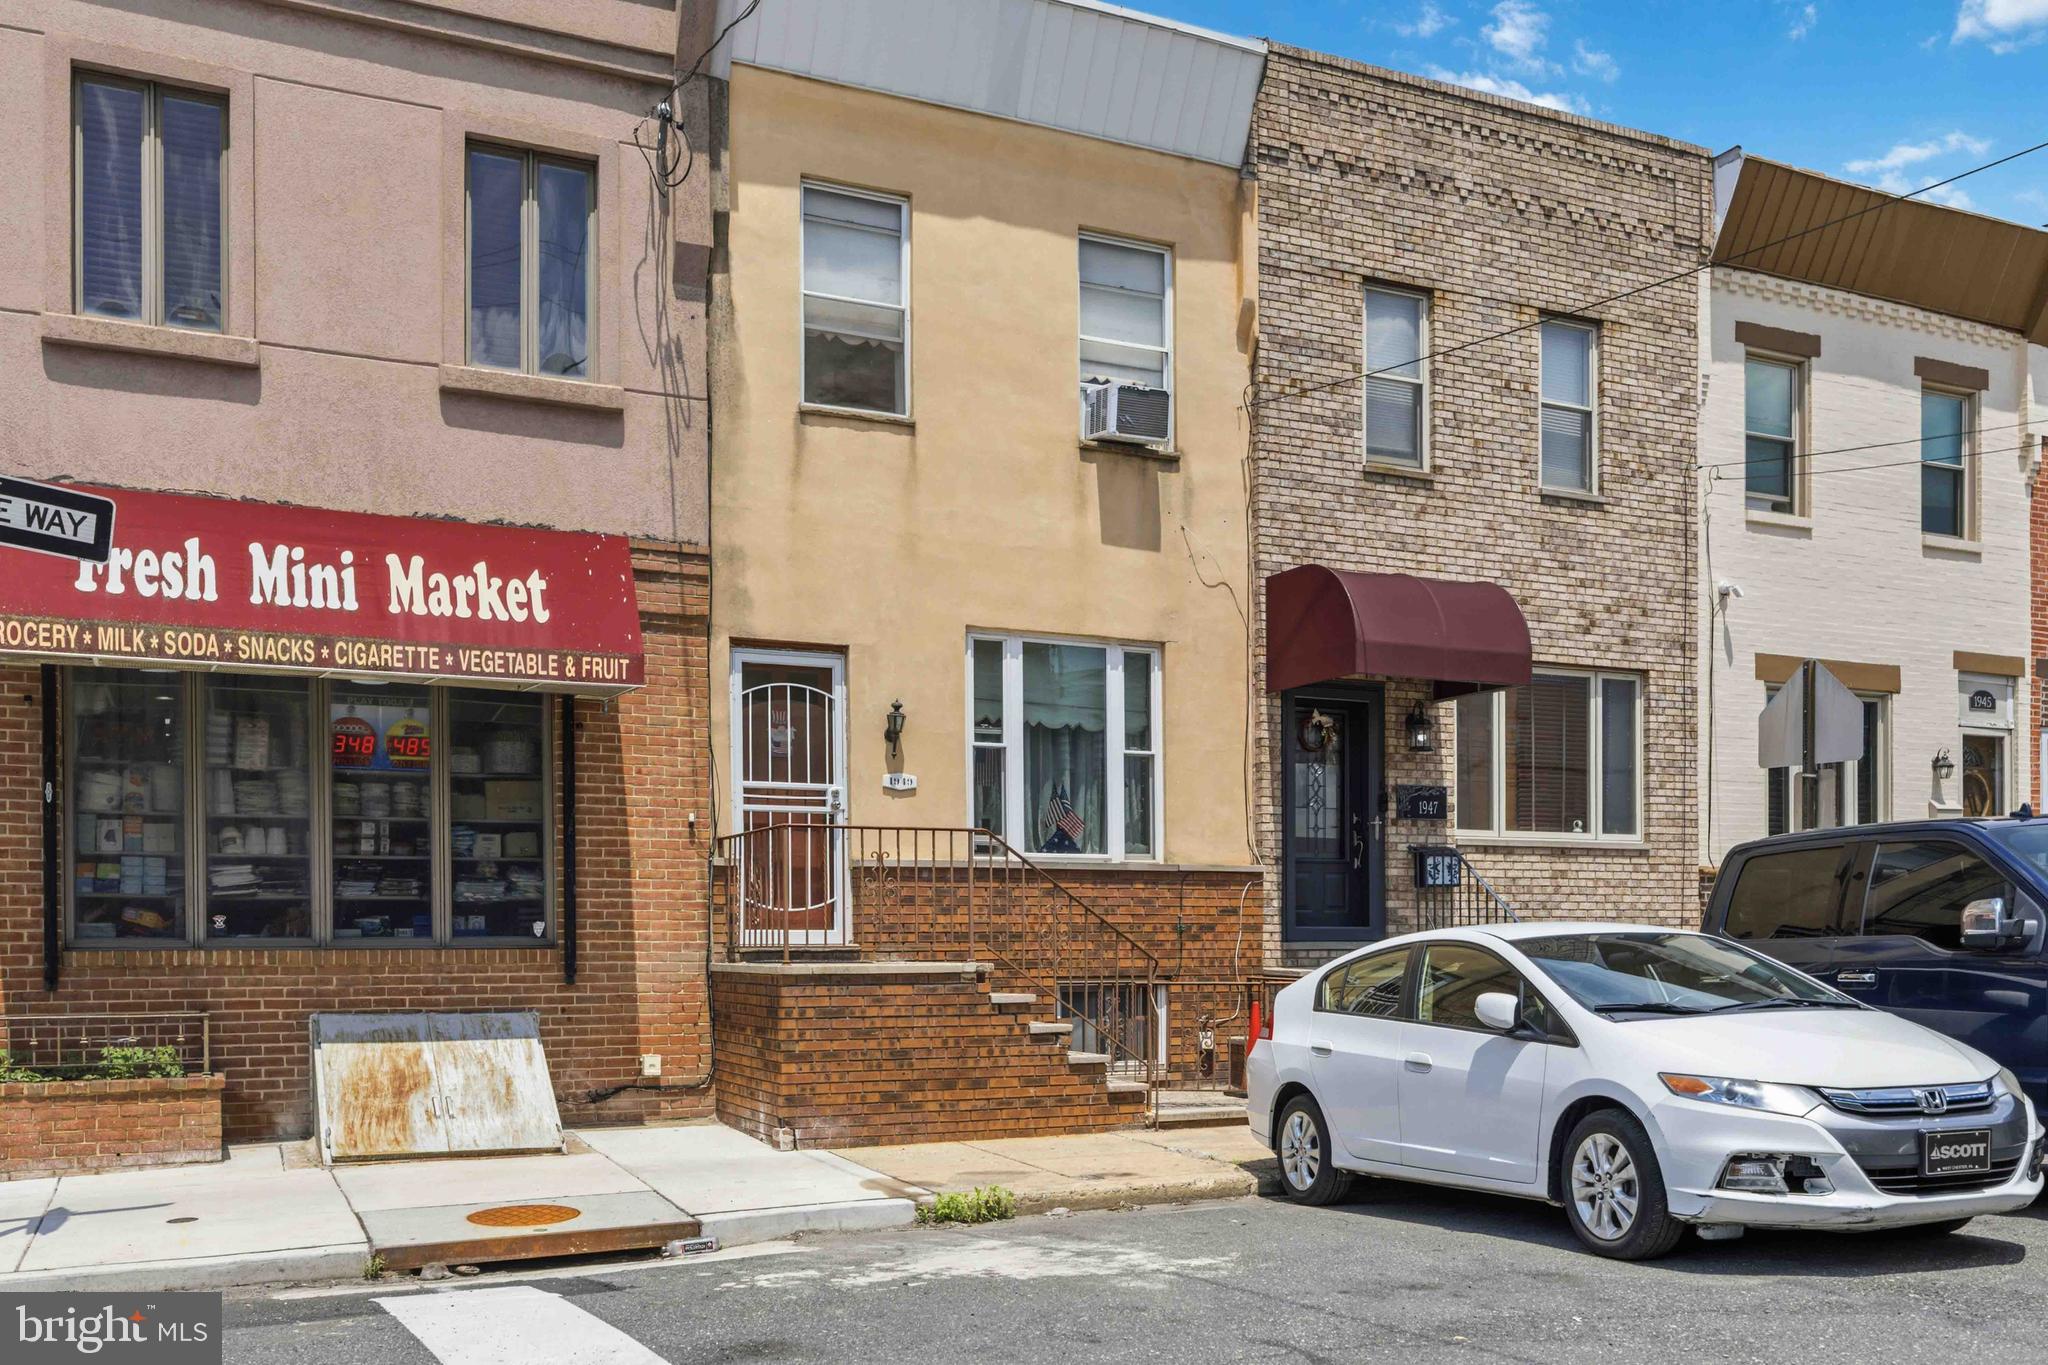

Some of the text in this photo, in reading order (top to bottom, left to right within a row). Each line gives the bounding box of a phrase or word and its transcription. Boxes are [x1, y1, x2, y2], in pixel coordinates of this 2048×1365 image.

[25, 503, 88, 538] WAY
[248, 542, 359, 611] Mini
[385, 553, 550, 624] Market
[97, 626, 146, 653] MILK
[164, 630, 220, 657] SODA
[238, 635, 316, 664] SNACKS
[334, 641, 440, 670] CIGARETTE
[458, 648, 559, 676] VEGETABLE
[565, 655, 577, 678] &
[581, 656, 630, 680] FRUIT
[1973, 695, 1993, 709] 1945
[334, 735, 376, 754] 348
[393, 738, 431, 757] 485
[1418, 800, 1439, 815] 1947
[1940, 1143, 1987, 1159] SCOTT
